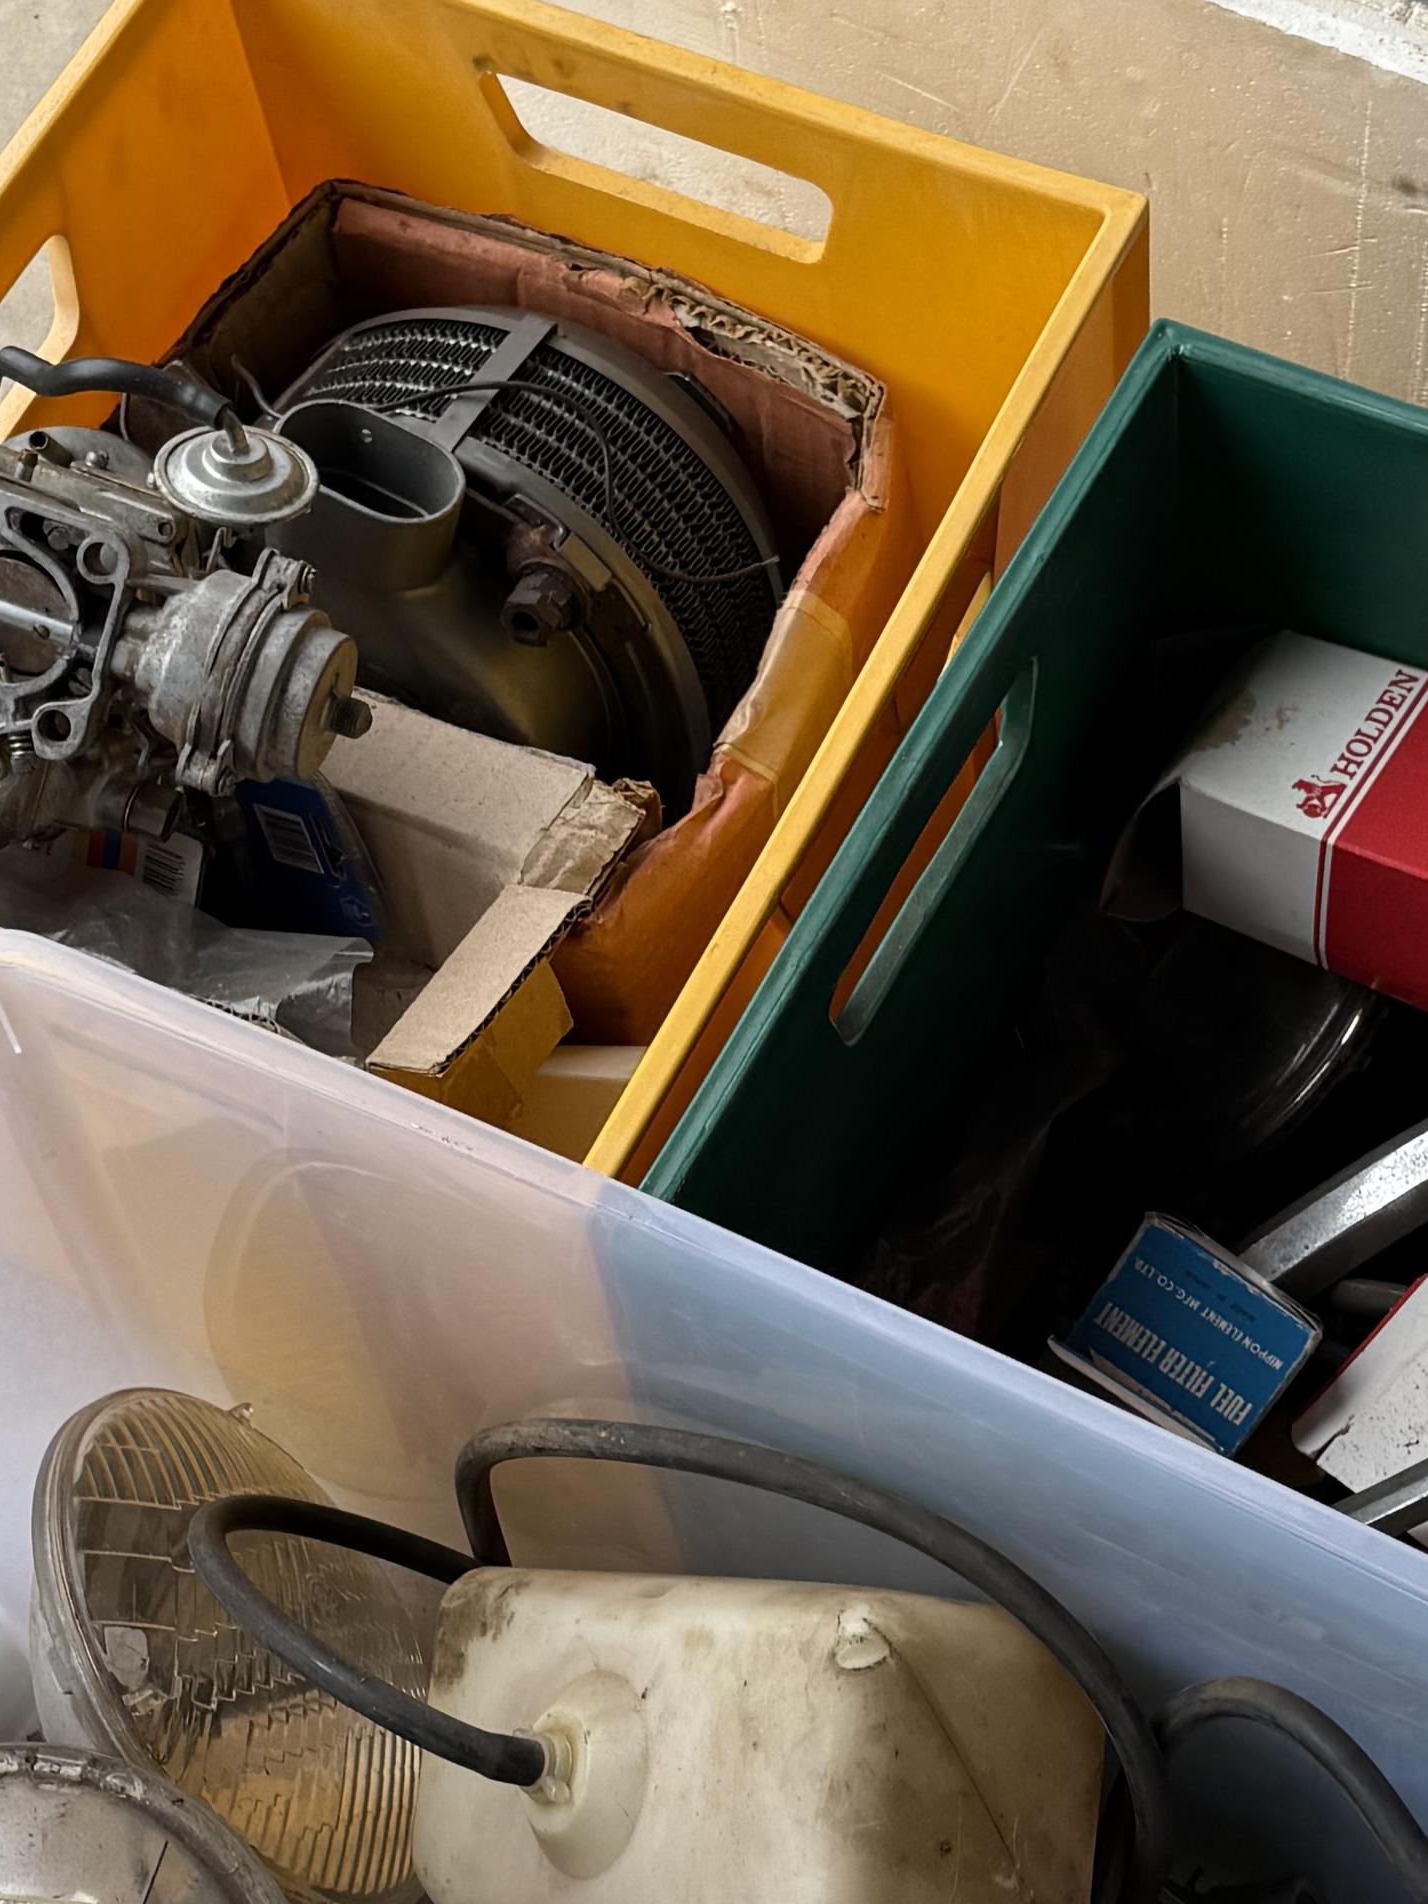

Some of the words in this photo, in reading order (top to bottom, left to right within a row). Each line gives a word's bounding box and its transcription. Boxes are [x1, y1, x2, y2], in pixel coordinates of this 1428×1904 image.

[1329, 669, 1420, 779] HOLDEN
[1092, 1300, 1166, 1364] ELEMENT
[1200, 1306, 1244, 1341] ELEMENT
[1156, 1346, 1215, 1399] FILTER
[1241, 1335, 1283, 1370] NIPPON
[1207, 1381, 1253, 1426] FUEL
